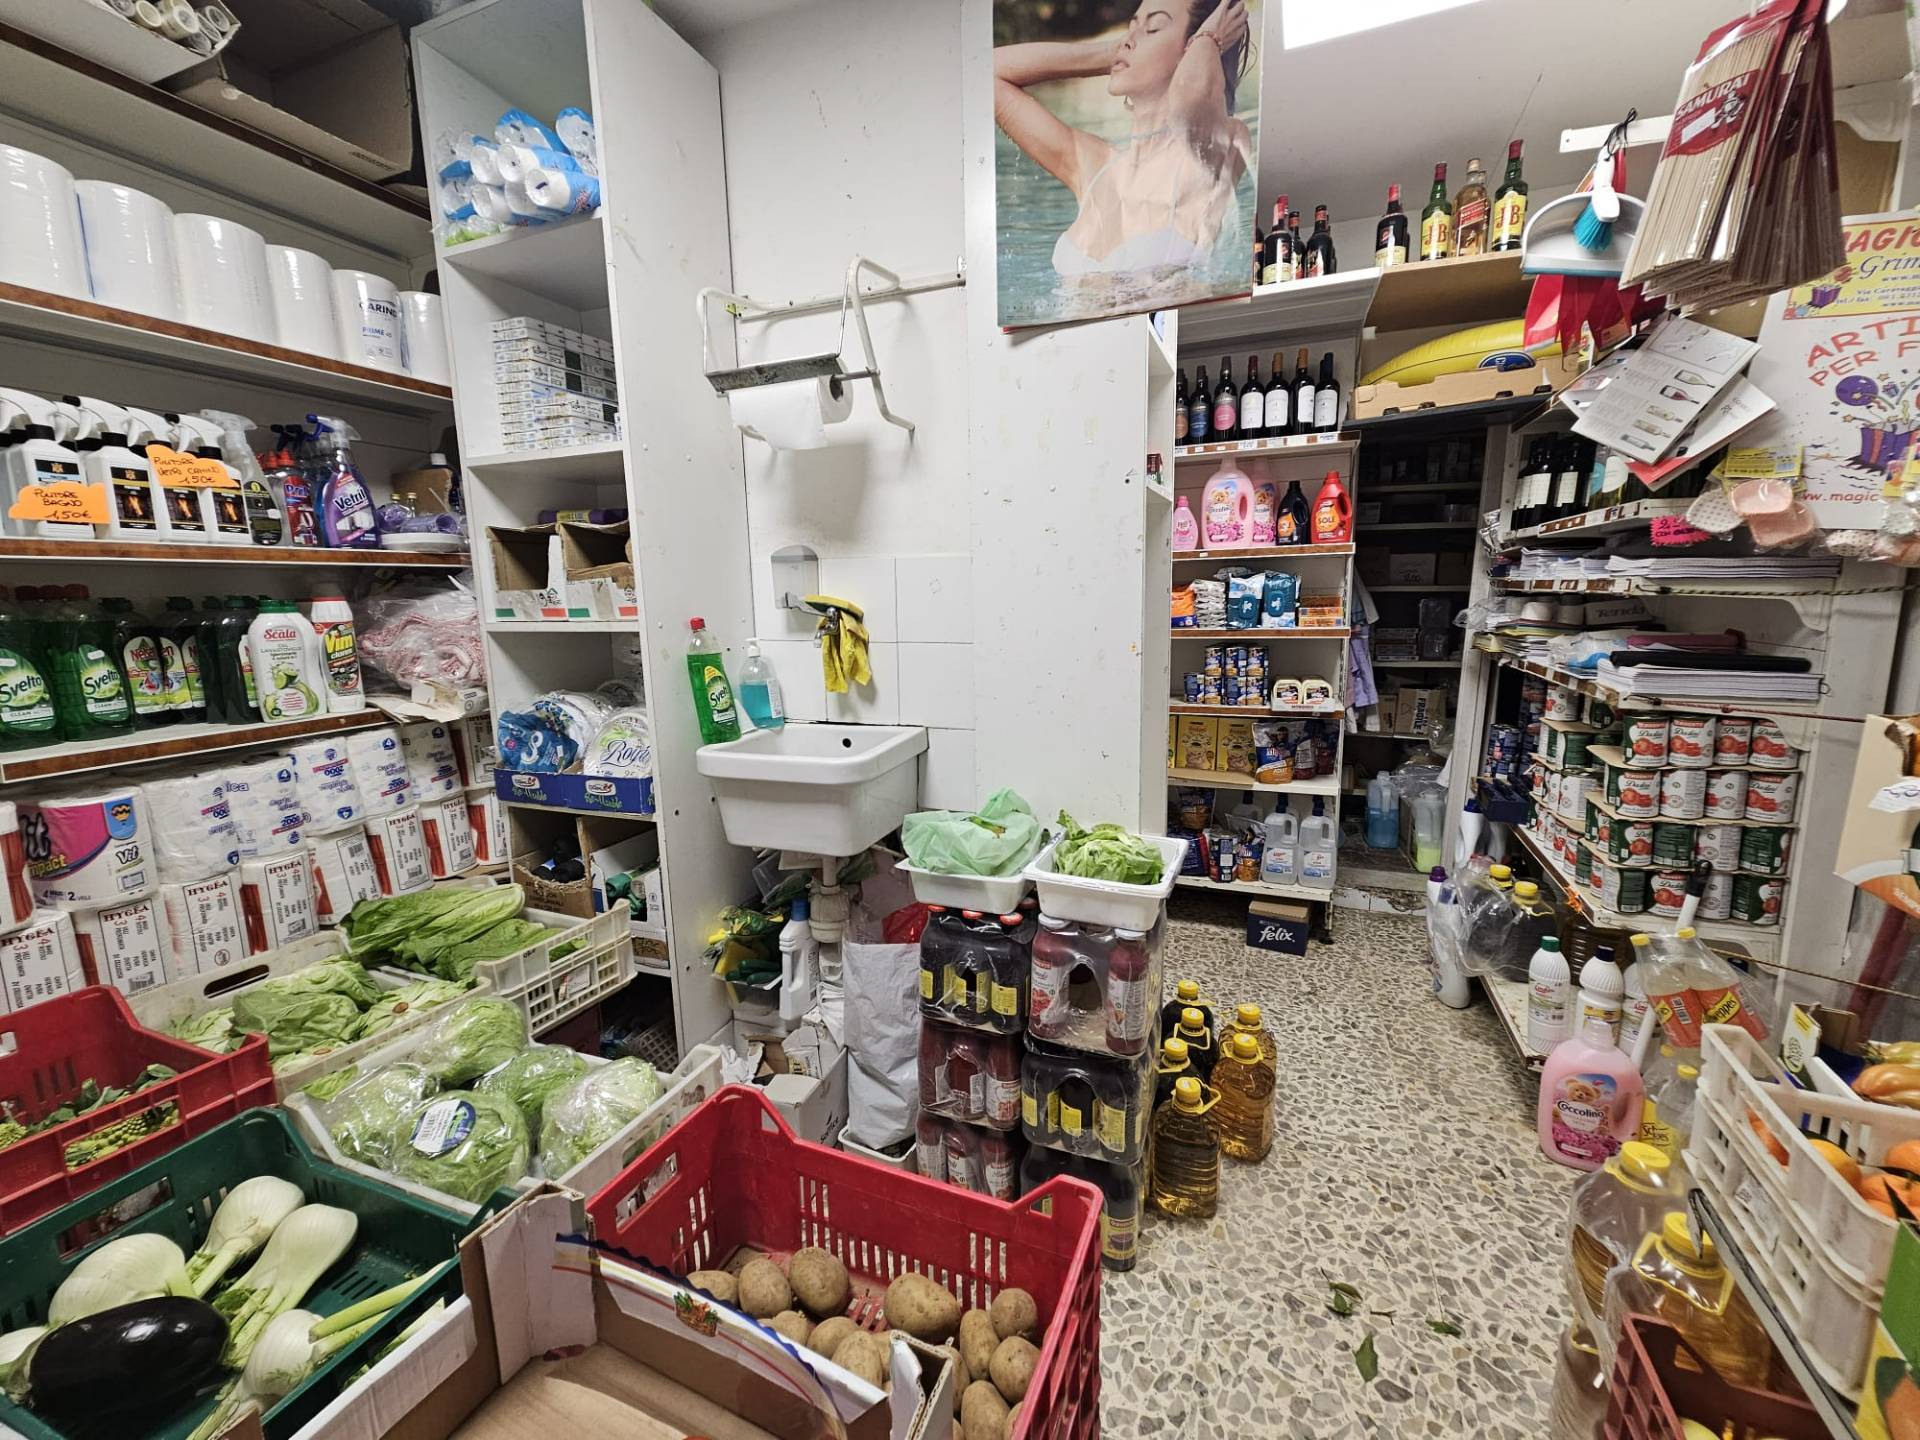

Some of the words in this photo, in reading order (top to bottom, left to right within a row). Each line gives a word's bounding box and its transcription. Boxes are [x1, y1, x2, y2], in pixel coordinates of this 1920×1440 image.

[1675, 73, 1750, 121] SAMURAI
[1808, 351, 1880, 387] PER
[178, 475, 216, 485] 1,50€
[43, 497, 83, 508] BAGNO
[334, 487, 367, 511] Vetril
[46, 509, 92, 520] 1,50€
[1317, 516, 1335, 524] SOLE
[264, 628, 297, 640] Scala
[325, 633, 353, 654] Vim
[84, 669, 120, 695] Svelto
[115, 845, 139, 865] Vit
[67, 892, 76, 901] 2
[1258, 925, 1293, 943] felix
[1557, 1100, 1605, 1118] Coccolino
